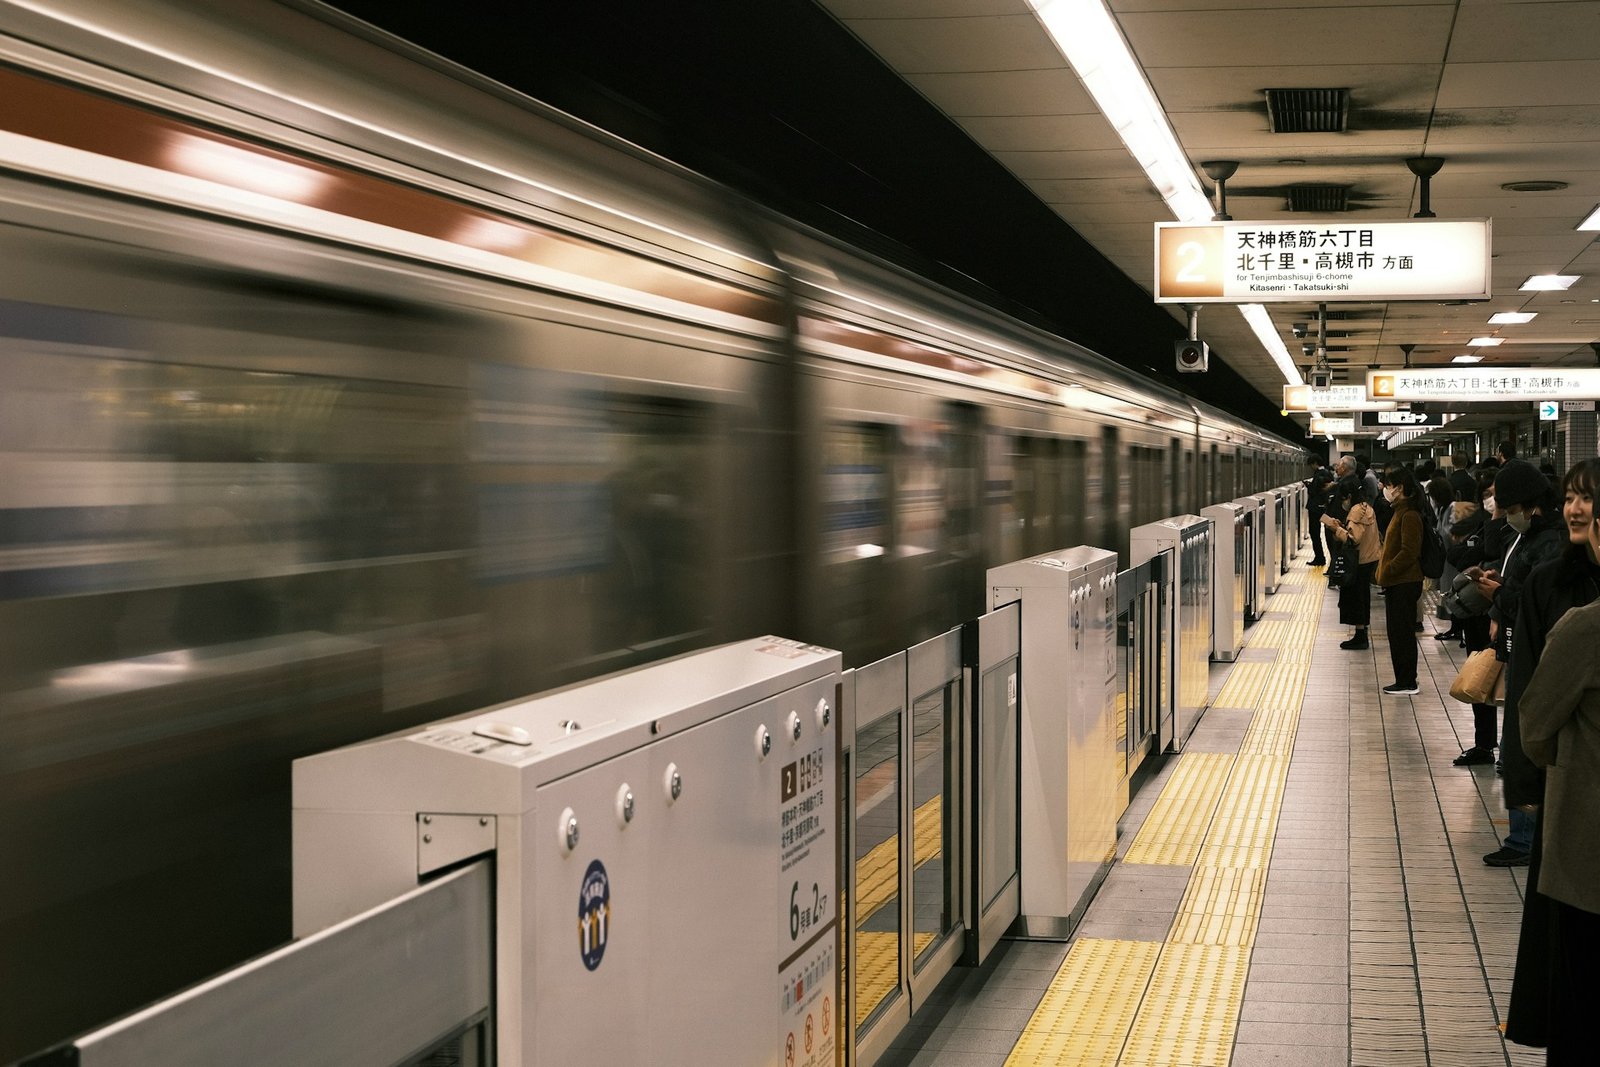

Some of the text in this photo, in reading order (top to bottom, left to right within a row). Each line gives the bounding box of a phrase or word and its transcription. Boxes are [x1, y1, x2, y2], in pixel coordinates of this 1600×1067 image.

[1237, 229, 1373, 249] 天神橋筋六丁目
[1176, 241, 1206, 282] 2
[1237, 251, 1414, 271] 北千里・高槻市 方面
[1249, 283, 1286, 292] Kitasenri
[1293, 282, 1349, 292] Takatsuki-shi
[1250, 273, 1315, 283] Tenjimbashisuji
[1316, 273, 1353, 281] 6-chome
[1379, 379, 1389, 394] 2
[786, 770, 792, 794] 2
